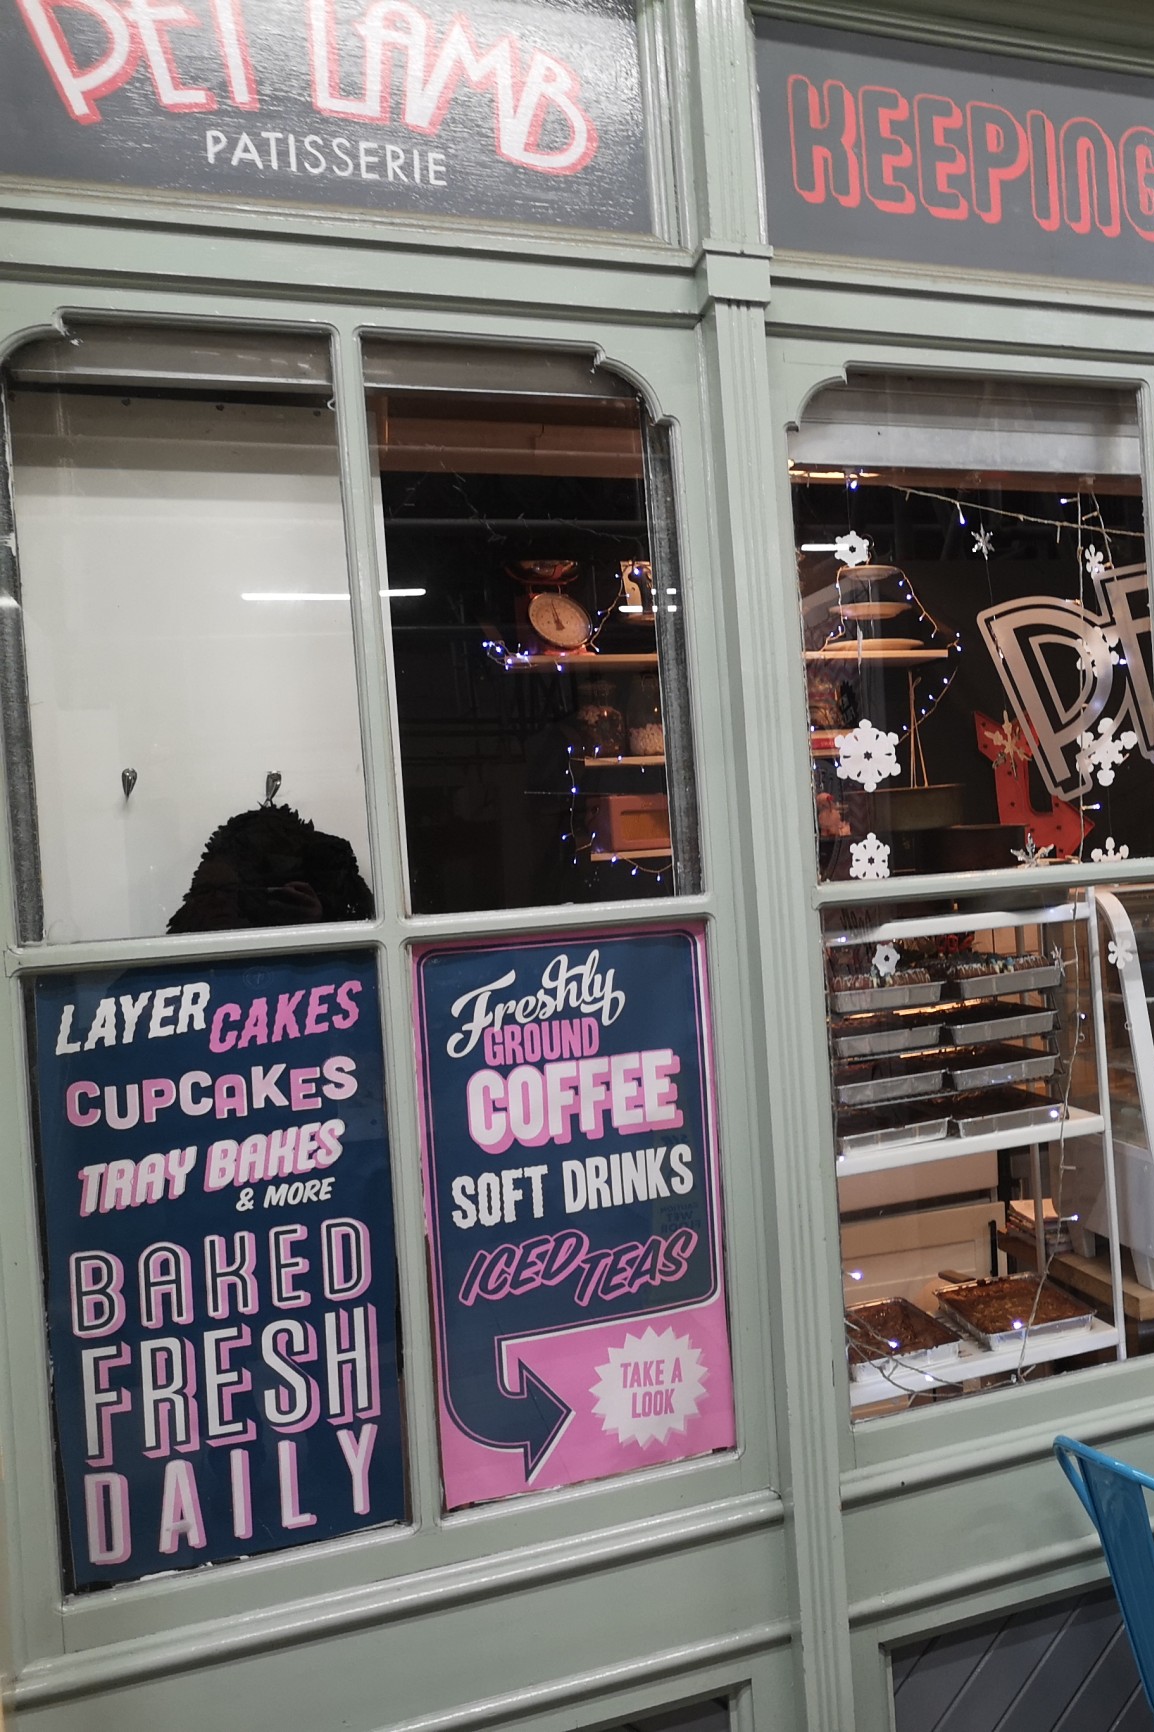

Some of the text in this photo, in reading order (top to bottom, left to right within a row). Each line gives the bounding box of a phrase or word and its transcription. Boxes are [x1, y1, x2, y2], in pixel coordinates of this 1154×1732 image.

[19, 0, 601, 175] PET LAMB
[205, 130, 448, 187] PATISSERIE
[55, 979, 363, 1055] LAYER CAKES
[446, 949, 626, 1059] Freshly
[483, 1017, 600, 1067] GROUND
[64, 1055, 359, 1131] CUPCAKES
[466, 1048, 684, 1154] COFFEE
[78, 1119, 346, 1217] TRAY BAKES
[235, 1177, 336, 1212] & MORE
[450, 1144, 694, 1230] SOFT DRINKS
[69, 1217, 372, 1339] BAKED
[458, 1227, 699, 1307] ICED TEAS
[81, 1305, 383, 1467] FRESH
[620, 1357, 683, 1389] TAKE A
[631, 1388, 676, 1419] LOOK
[83, 1422, 379, 1566] DAILY
